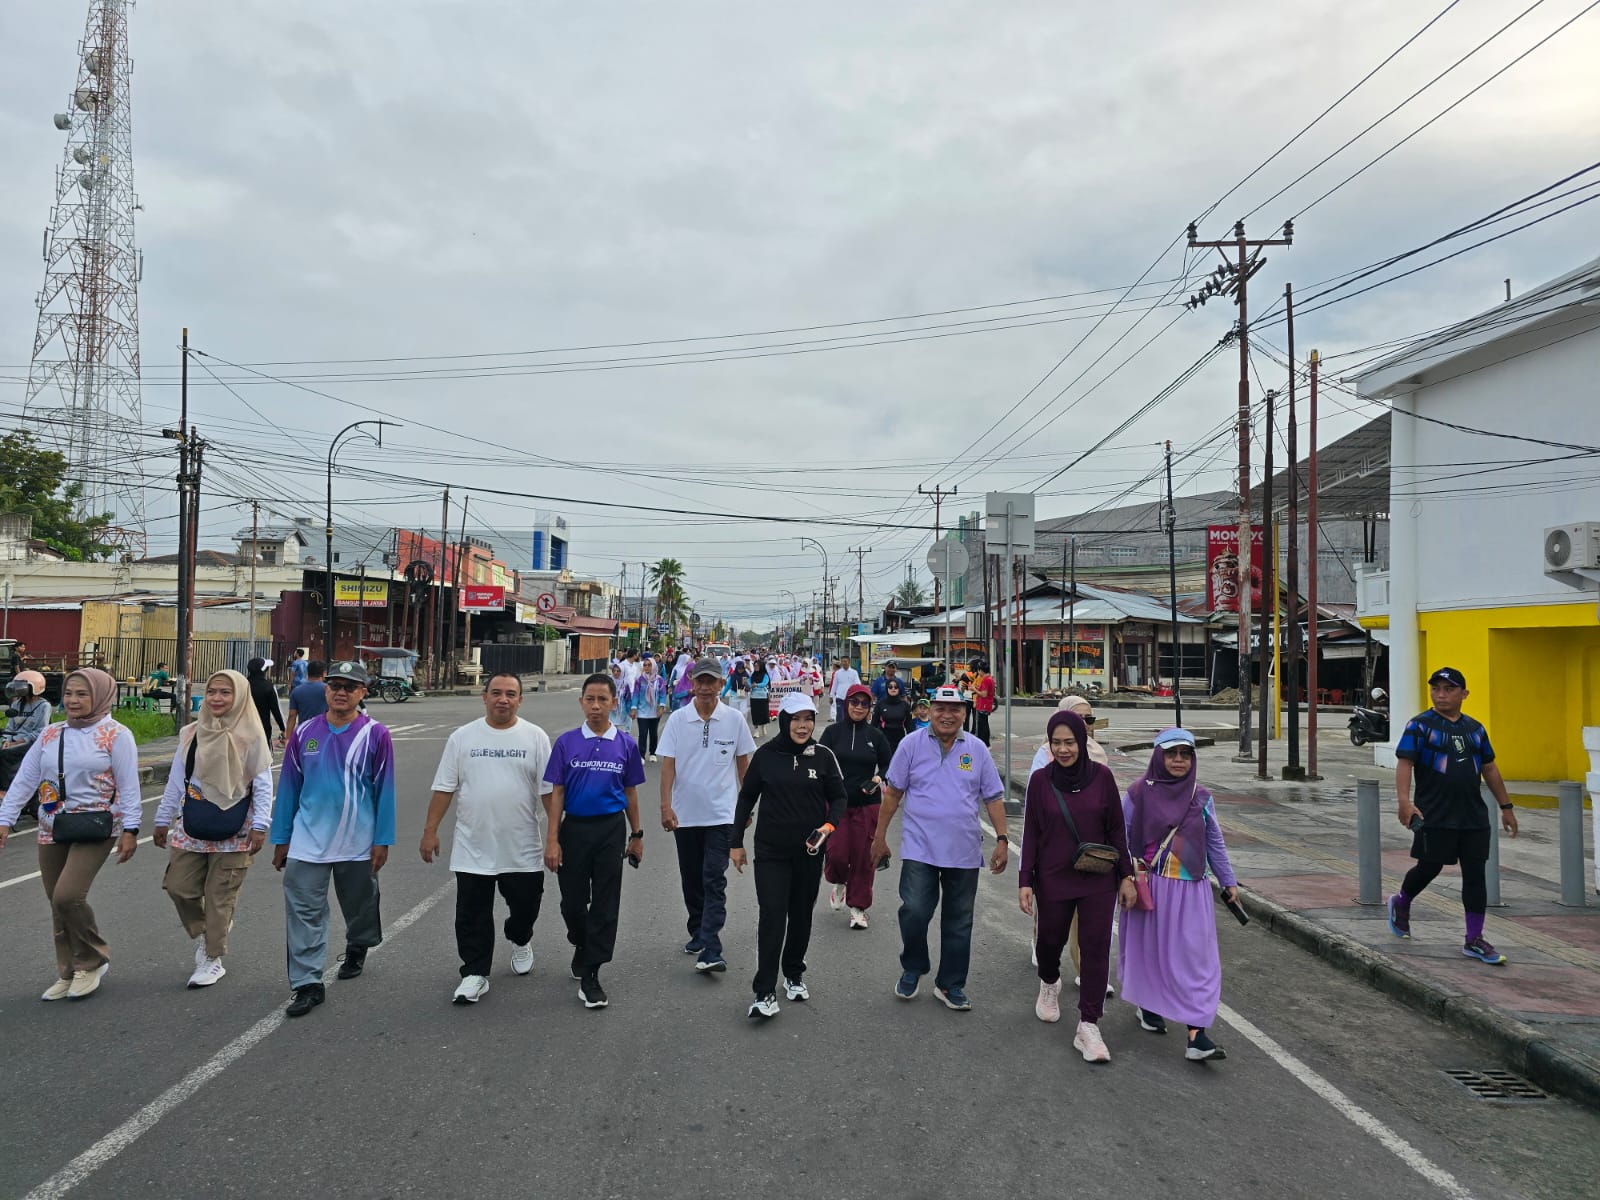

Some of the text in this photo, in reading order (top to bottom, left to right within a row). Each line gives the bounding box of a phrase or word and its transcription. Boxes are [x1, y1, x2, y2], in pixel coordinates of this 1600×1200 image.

[1209, 530, 1264, 541] MOMY
[471, 748, 528, 759] GREENLIGHT
[807, 768, 818, 779] R
